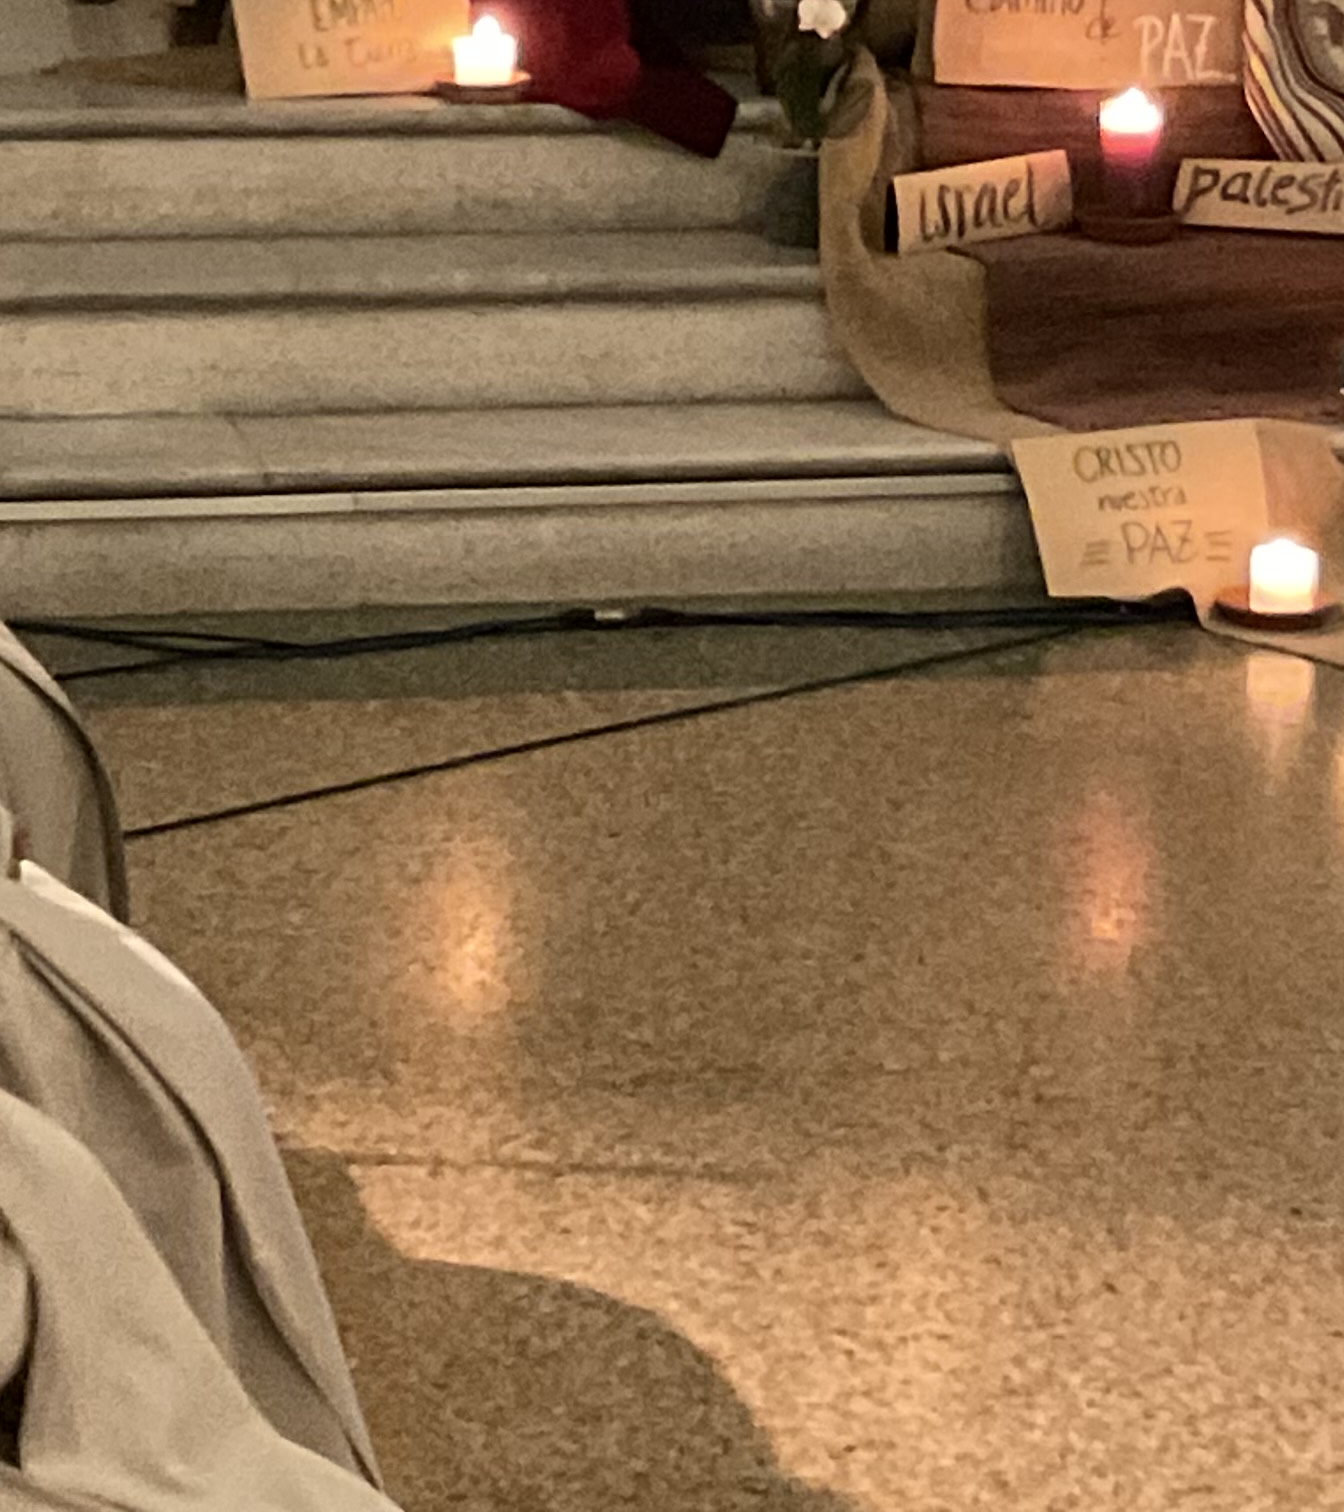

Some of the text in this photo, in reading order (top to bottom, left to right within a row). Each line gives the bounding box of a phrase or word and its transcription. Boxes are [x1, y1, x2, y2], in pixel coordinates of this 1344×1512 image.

[1133, 12, 1238, 84] PAZ
[1072, 439, 1183, 485] CRISTO
[1120, 518, 1201, 566] PAZ
